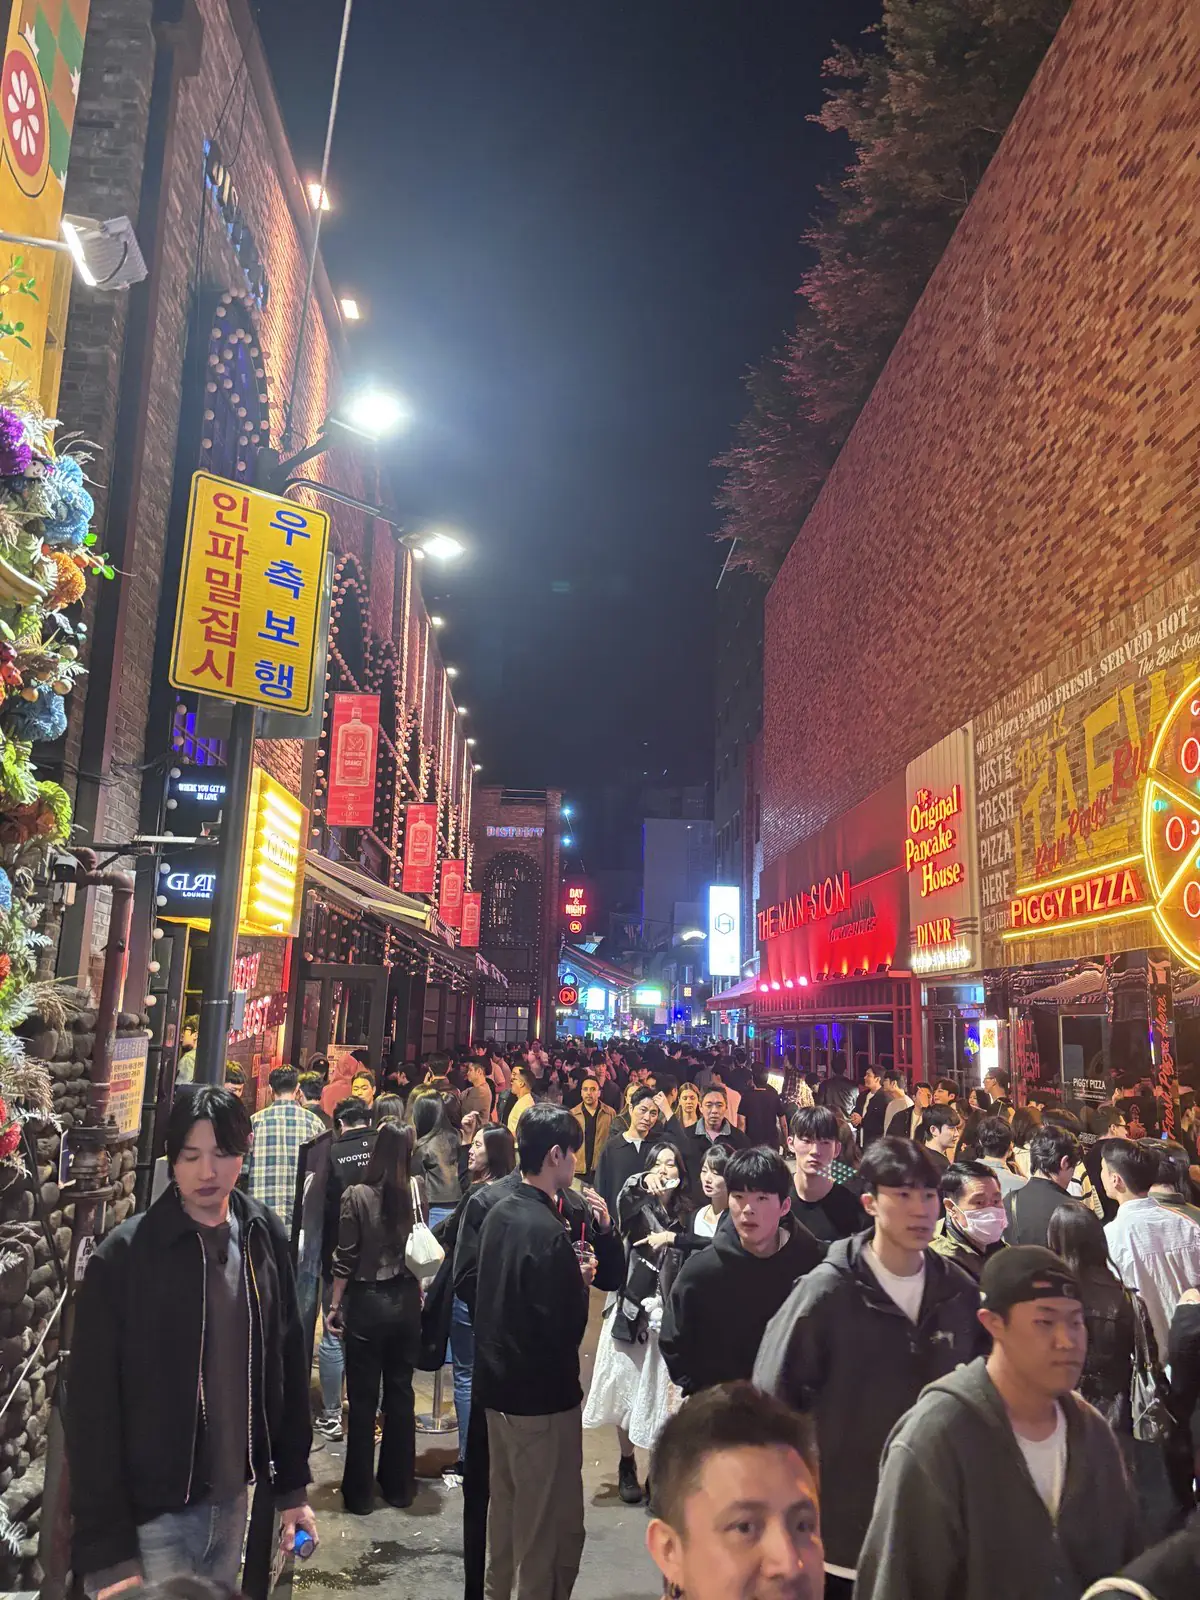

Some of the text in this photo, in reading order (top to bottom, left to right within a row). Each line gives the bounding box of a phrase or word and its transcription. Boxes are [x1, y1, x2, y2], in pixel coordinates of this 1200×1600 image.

[191, 492, 250, 688] 인파밀집시
[254, 509, 311, 700] 우측보행
[1138, 656, 1155, 678] The
[1156, 639, 1179, 666] Best
[977, 735, 994, 756] OUR
[1025, 694, 1054, 730] MADE
[1055, 667, 1098, 707] FRESH,
[1100, 629, 1152, 678] SERVED
[1156, 604, 1189, 642] HOT
[198, 784, 209, 793] YOU
[210, 785, 219, 793] GET
[978, 755, 1003, 795] JUST
[204, 793, 218, 801] LOVE
[910, 785, 959, 834] Original
[917, 788, 929, 804] The
[978, 787, 1015, 832] FRESH
[905, 826, 955, 872] Pancake
[980, 829, 1012, 870] PIZZA
[569, 888, 584, 898] DAY
[920, 862, 962, 898] House
[981, 870, 1011, 907] HERE
[1011, 869, 1138, 928] PIGGY PIZZA
[565, 904, 587, 915] NIGHT
[757, 905, 778, 941] THE
[778, 870, 849, 934] MANSION
[917, 917, 952, 947] DINER
[1073, 1078, 1107, 1090] PIGGY PIZZA
[1158, 1040, 1175, 1089] Pizza
[1161, 1090, 1176, 1140] Fresh
